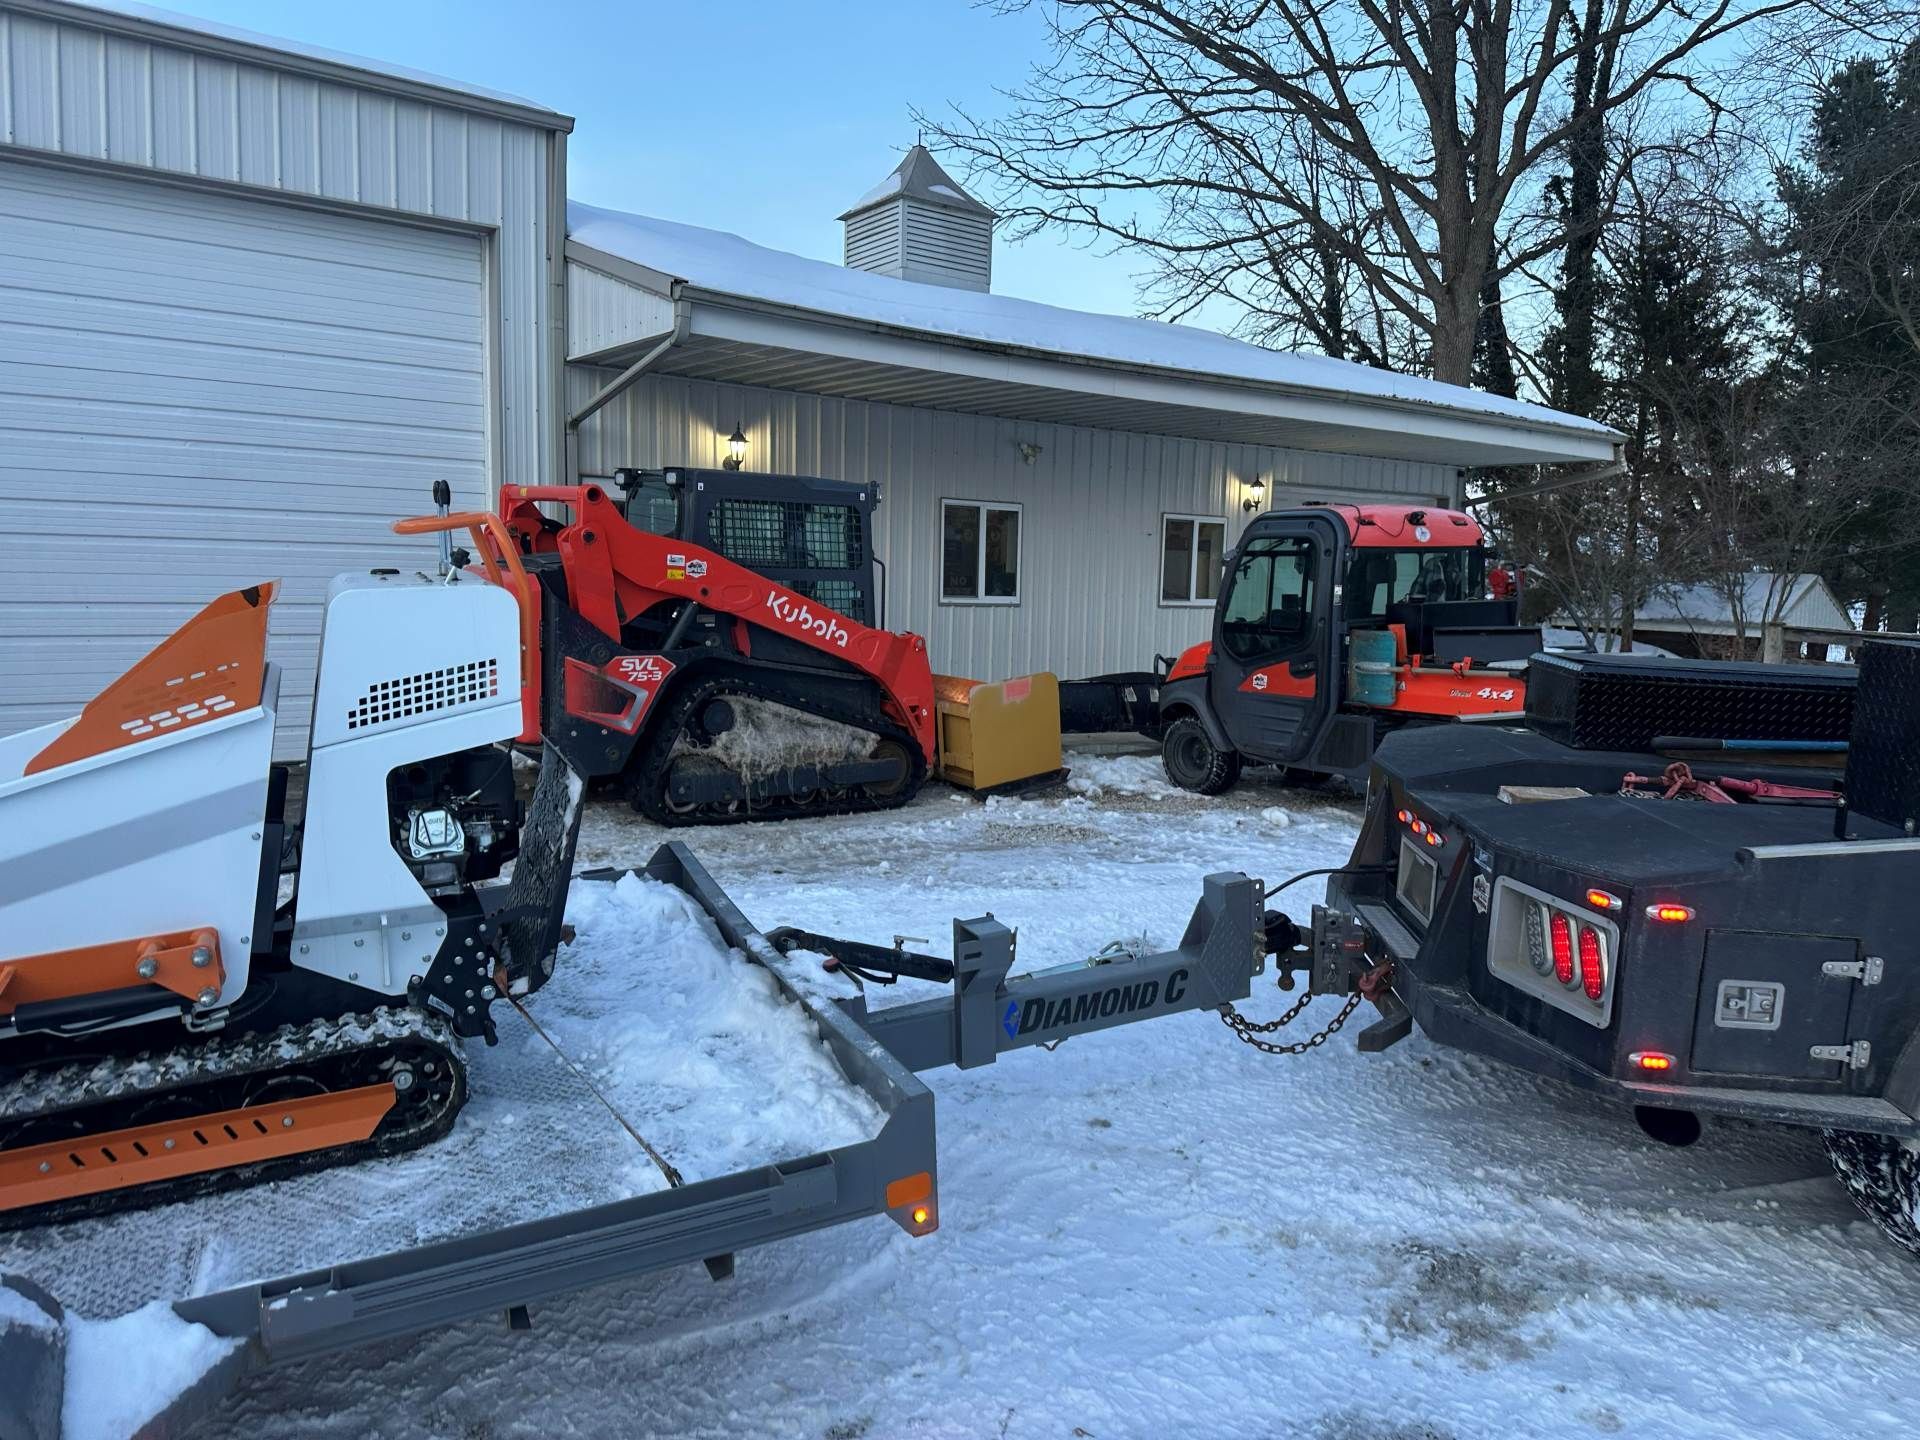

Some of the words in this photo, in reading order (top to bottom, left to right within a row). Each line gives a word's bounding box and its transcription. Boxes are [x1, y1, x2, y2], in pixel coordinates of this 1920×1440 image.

[766, 590, 848, 648] Kubota
[619, 658, 660, 671] SVL
[627, 670, 662, 682] 75-3
[1476, 687, 1514, 701] 4x4
[1017, 980, 1160, 1035] DIAMOND
[1164, 968, 1189, 1005] C
